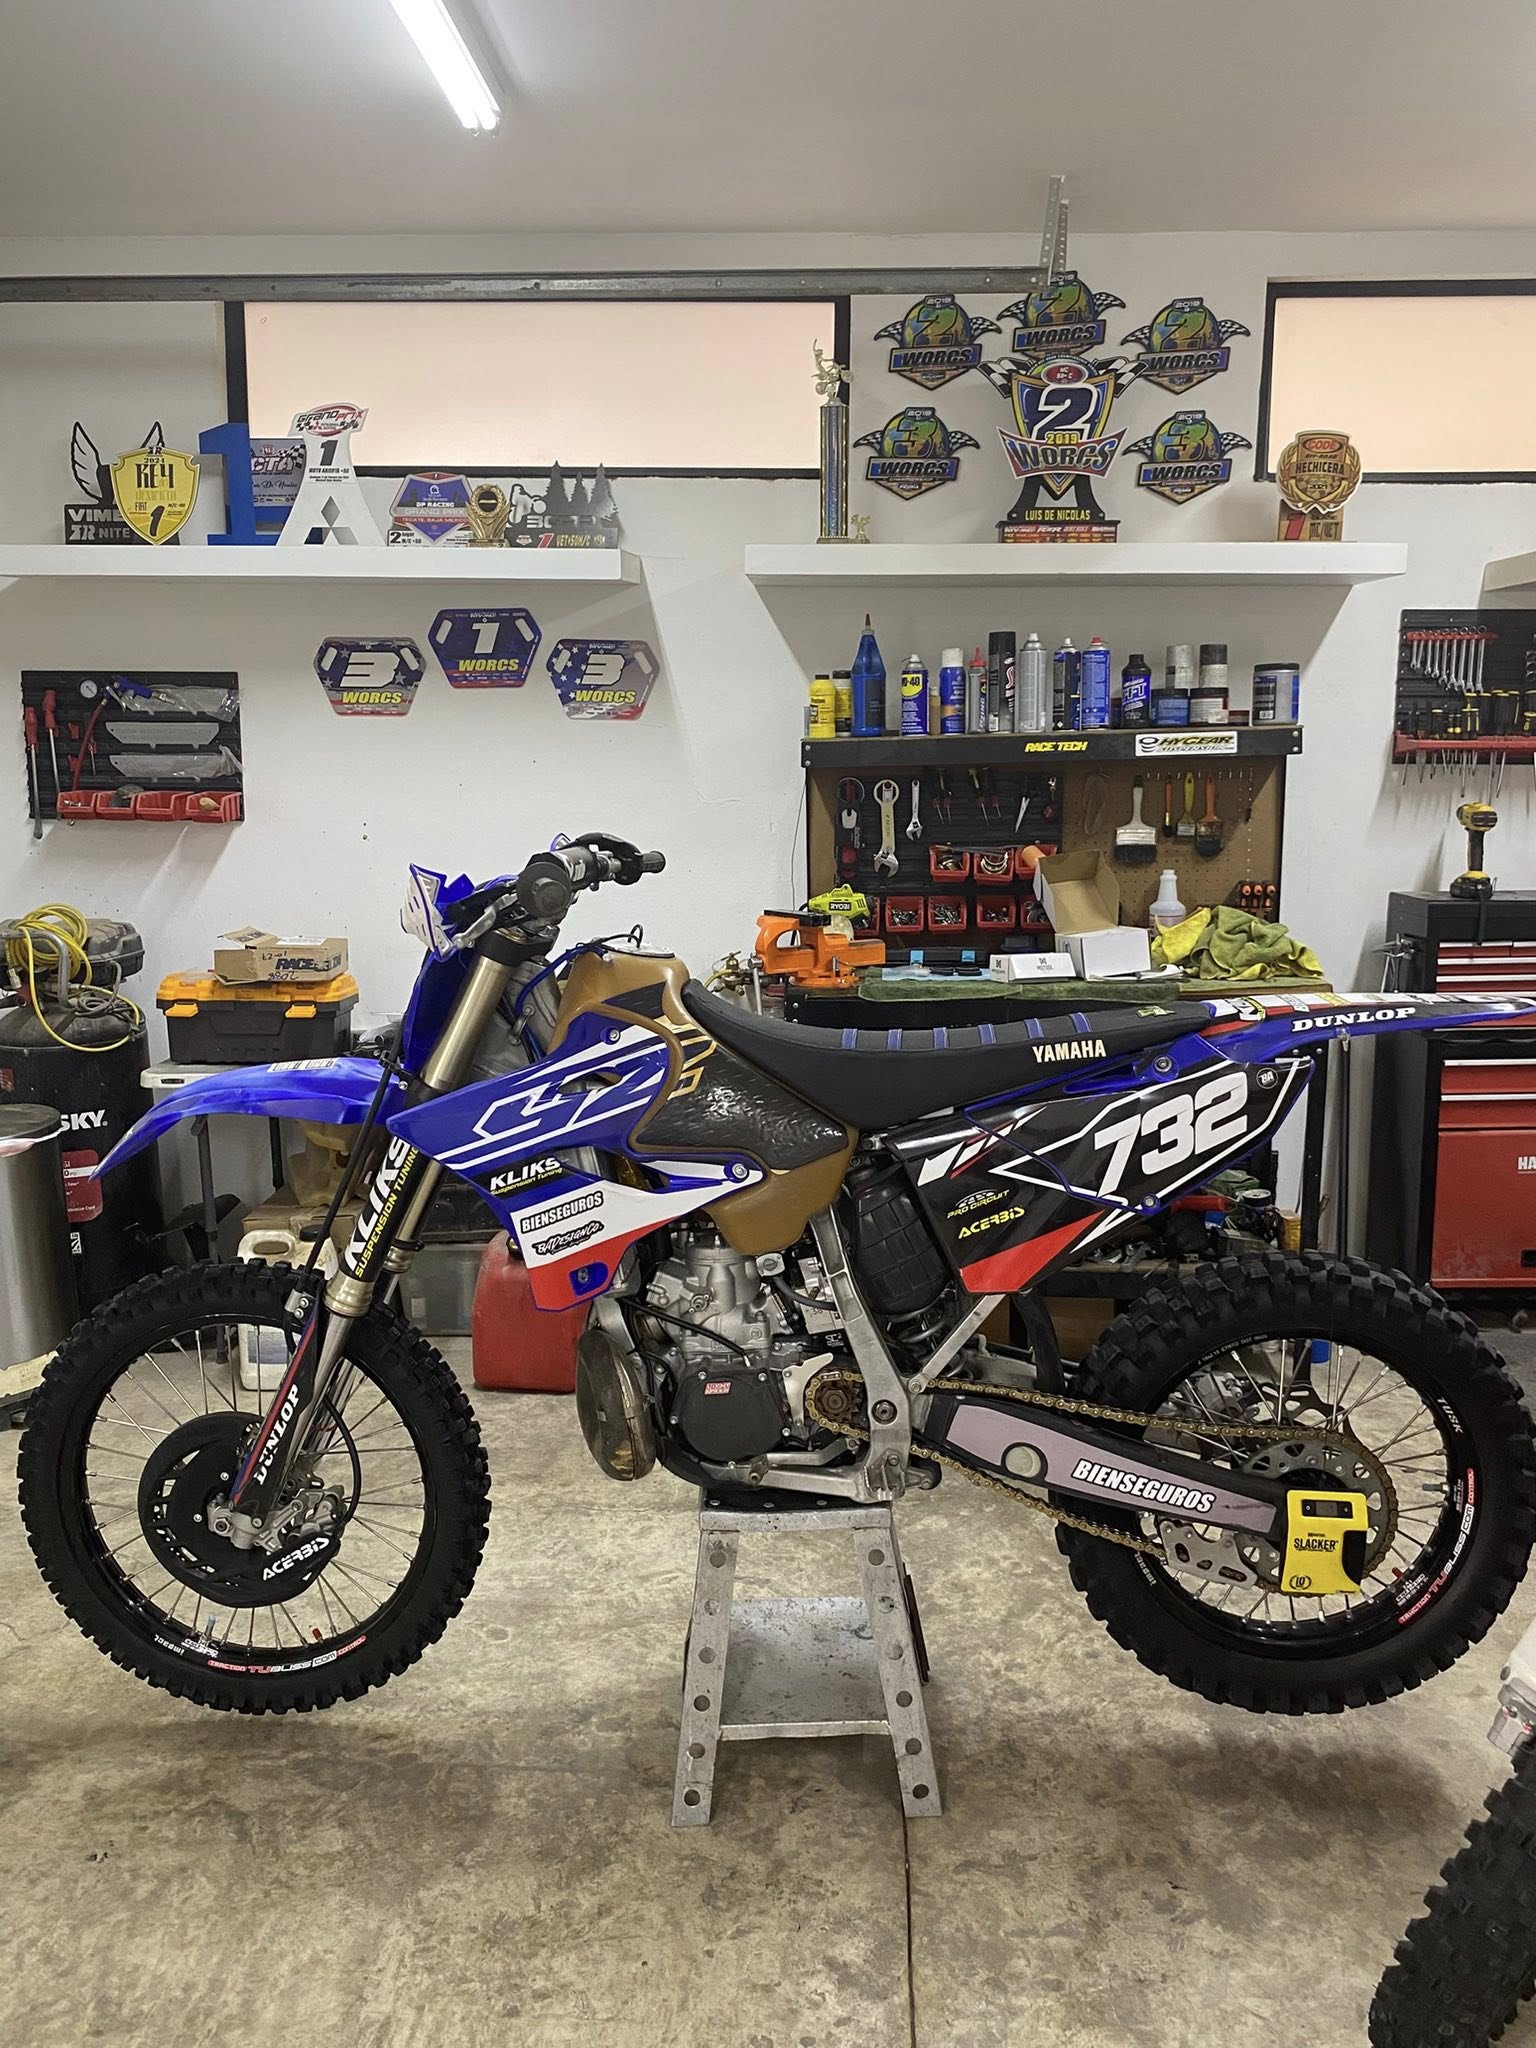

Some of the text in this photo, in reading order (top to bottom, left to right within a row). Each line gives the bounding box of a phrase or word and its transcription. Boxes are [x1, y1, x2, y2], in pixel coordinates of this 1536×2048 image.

[1026, 324, 1098, 345] WORCS
[902, 348, 974, 368] WORCS
[1148, 352, 1222, 371] WORCS
[1032, 385, 1096, 440] 2
[1046, 432, 1079, 445] 2019
[1308, 440, 1337, 450] CODE
[320, 440, 338, 466] 1
[1006, 438, 1118, 472] WORCS
[135, 463, 175, 489] KEY
[880, 461, 950, 477] WORCS
[1152, 463, 1222, 482] WORCS
[1295, 461, 1345, 475] HECHICERA
[150, 505, 165, 536] 1
[1025, 510, 1091, 521] LUIS DE NICOLAS
[99, 527, 131, 539] NITE
[390, 531, 402, 544] 2
[537, 532, 555, 549] 1
[472, 622, 500, 654] 1
[340, 652, 400, 687] 3
[459, 659, 519, 672] WORCS
[580, 654, 625, 686] 3
[342, 692, 402, 704] WORCS
[575, 690, 637, 703] WORCS
[1025, 741, 1089, 752] RACE TECH
[1159, 736, 1233, 746] HYGEAR
[276, 959, 316, 970] RACE
[1292, 1007, 1416, 1032] DUNLOP
[1032, 1040, 1107, 1063] YAMAHA
[1094, 1071, 1248, 1198] 732
[490, 1157, 561, 1191] KLIKS
[344, 1136, 411, 1272] KLIKS
[521, 1191, 603, 1233] BIENSEGUROS
[946, 1189, 1010, 1219] PRO CIRCUIT
[355, 1192, 398, 1278] SUSPENSION
[958, 1206, 1025, 1239] ACERBIS
[1436, 1396, 1464, 1434] TUSK
[253, 1383, 300, 1486] DUNLOP
[1072, 1459, 1215, 1512] BIENSEGUROS
[262, 1536, 331, 1581] ACERBIS
[1399, 1592, 1432, 1625] TRACTION
[154, 1634, 185, 1656] impact
[208, 1660, 247, 1672] TRACTION
[337, 1635, 367, 1656] CONTROL
